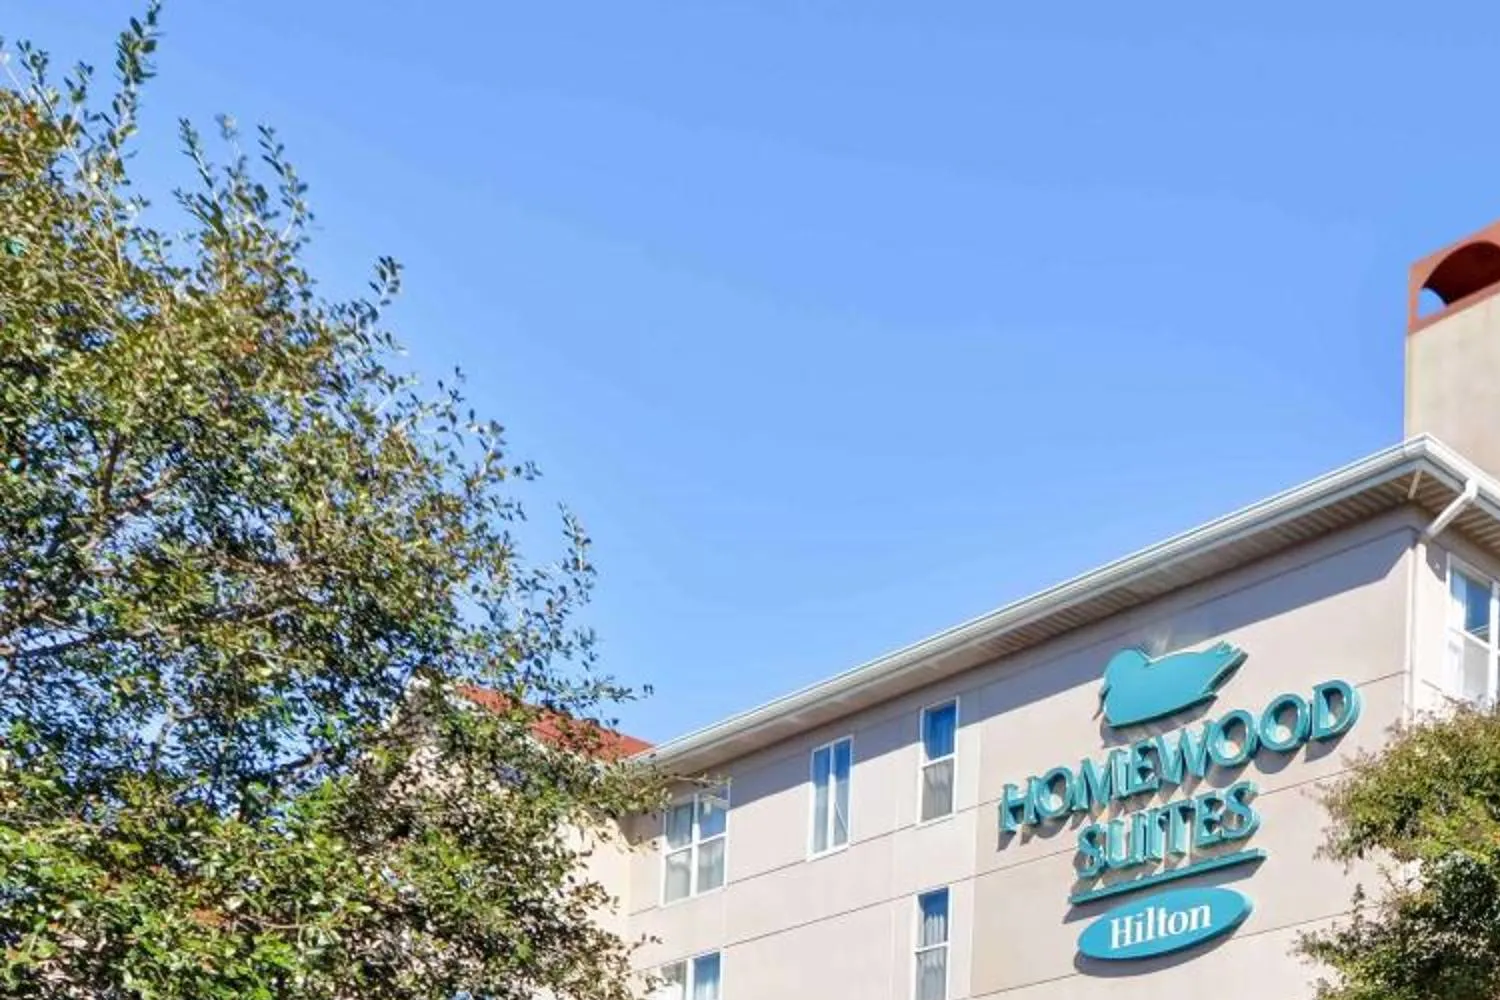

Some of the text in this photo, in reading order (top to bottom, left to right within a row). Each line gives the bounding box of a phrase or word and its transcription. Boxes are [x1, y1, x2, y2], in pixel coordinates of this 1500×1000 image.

[1000, 680, 1360, 833] HOMEWOOD
[1077, 782, 1260, 879] SUITES
[1110, 904, 1212, 950] Hilton
